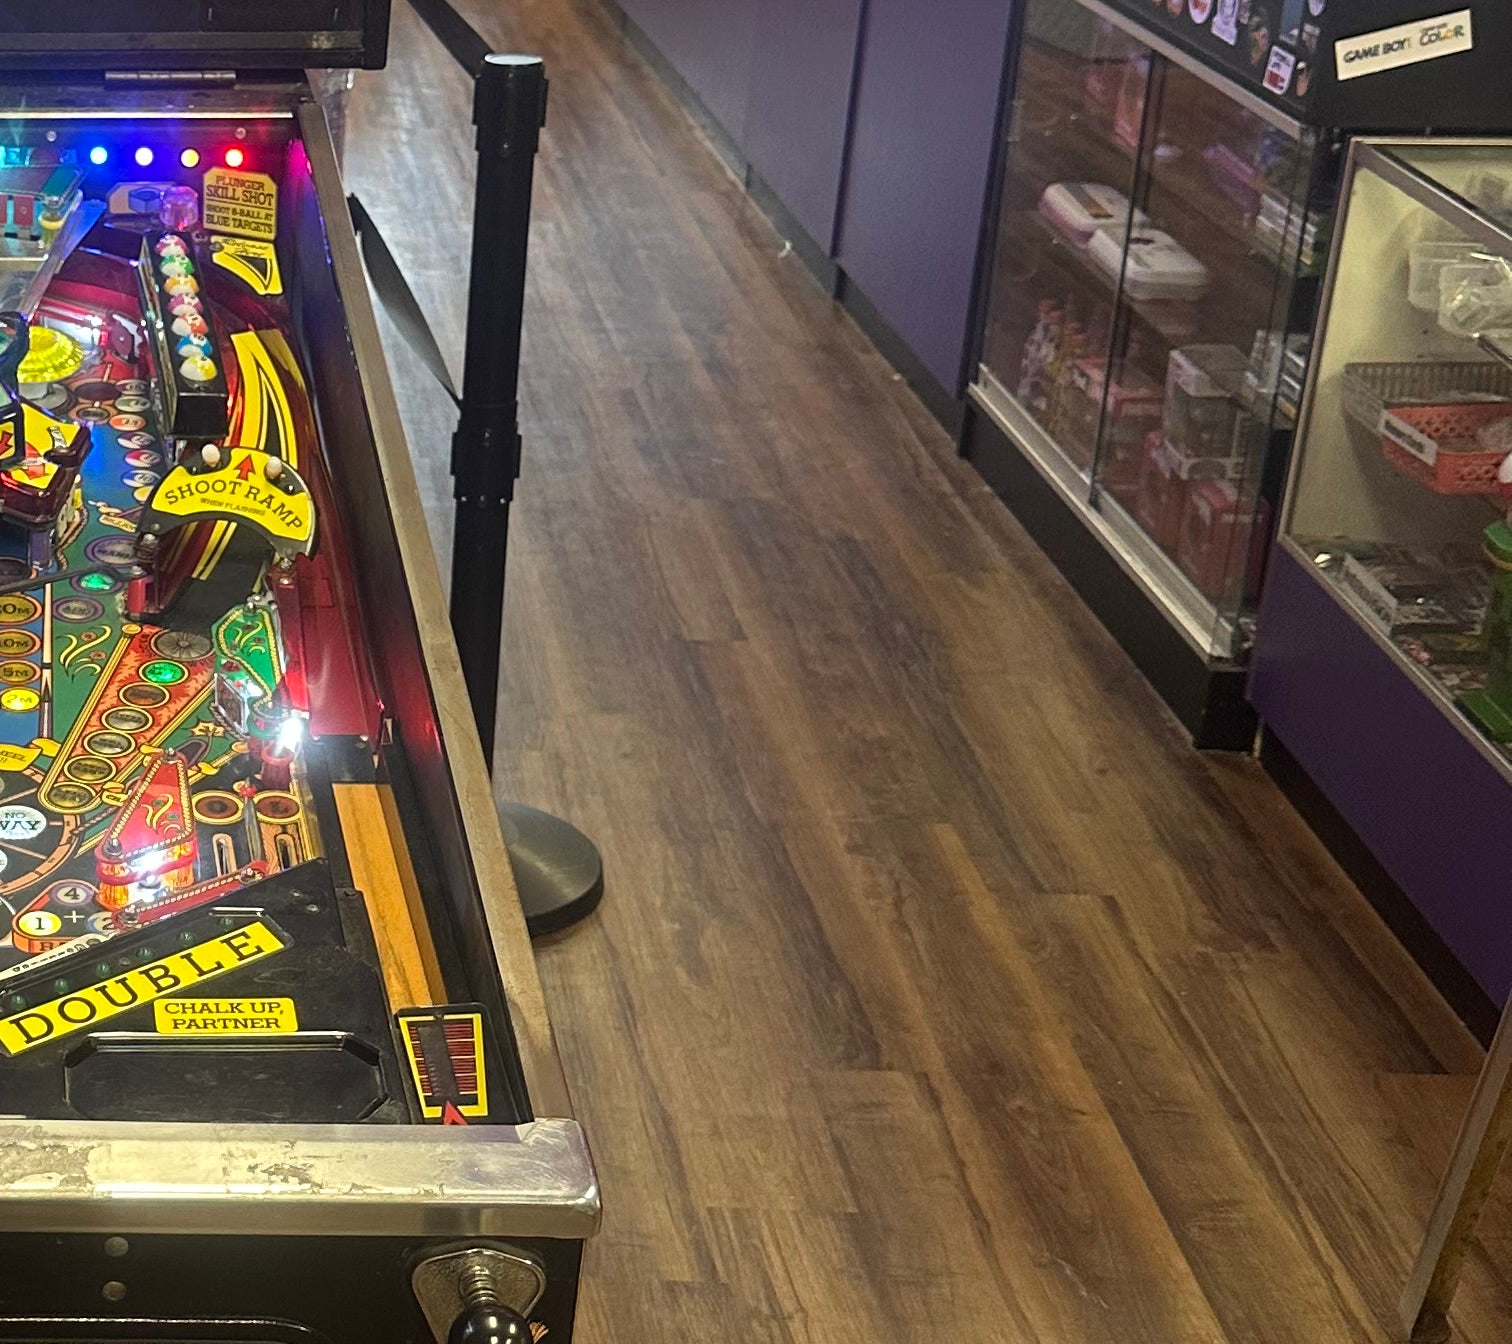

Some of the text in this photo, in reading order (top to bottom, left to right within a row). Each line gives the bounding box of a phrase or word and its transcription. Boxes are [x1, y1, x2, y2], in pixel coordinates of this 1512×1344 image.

[1343, 24, 1465, 63] GAME BOY COLOR
[215, 175, 265, 192] PLUNGER
[206, 185, 274, 207] SKILL SHOT
[206, 204, 231, 215] SHOOT
[205, 214, 273, 234] BLUE TARGETS
[164, 479, 304, 530] SHOOT RAMP
[3, 667, 34, 677] 5M
[6, 695, 33, 704] 2M
[63, 887, 81, 900] 4
[35, 917, 46, 930] 1
[10, 930, 264, 1044] DOUBLE
[164, 1000, 284, 1018] CHALK UP,
[172, 1017, 281, 1030] PARTNER
